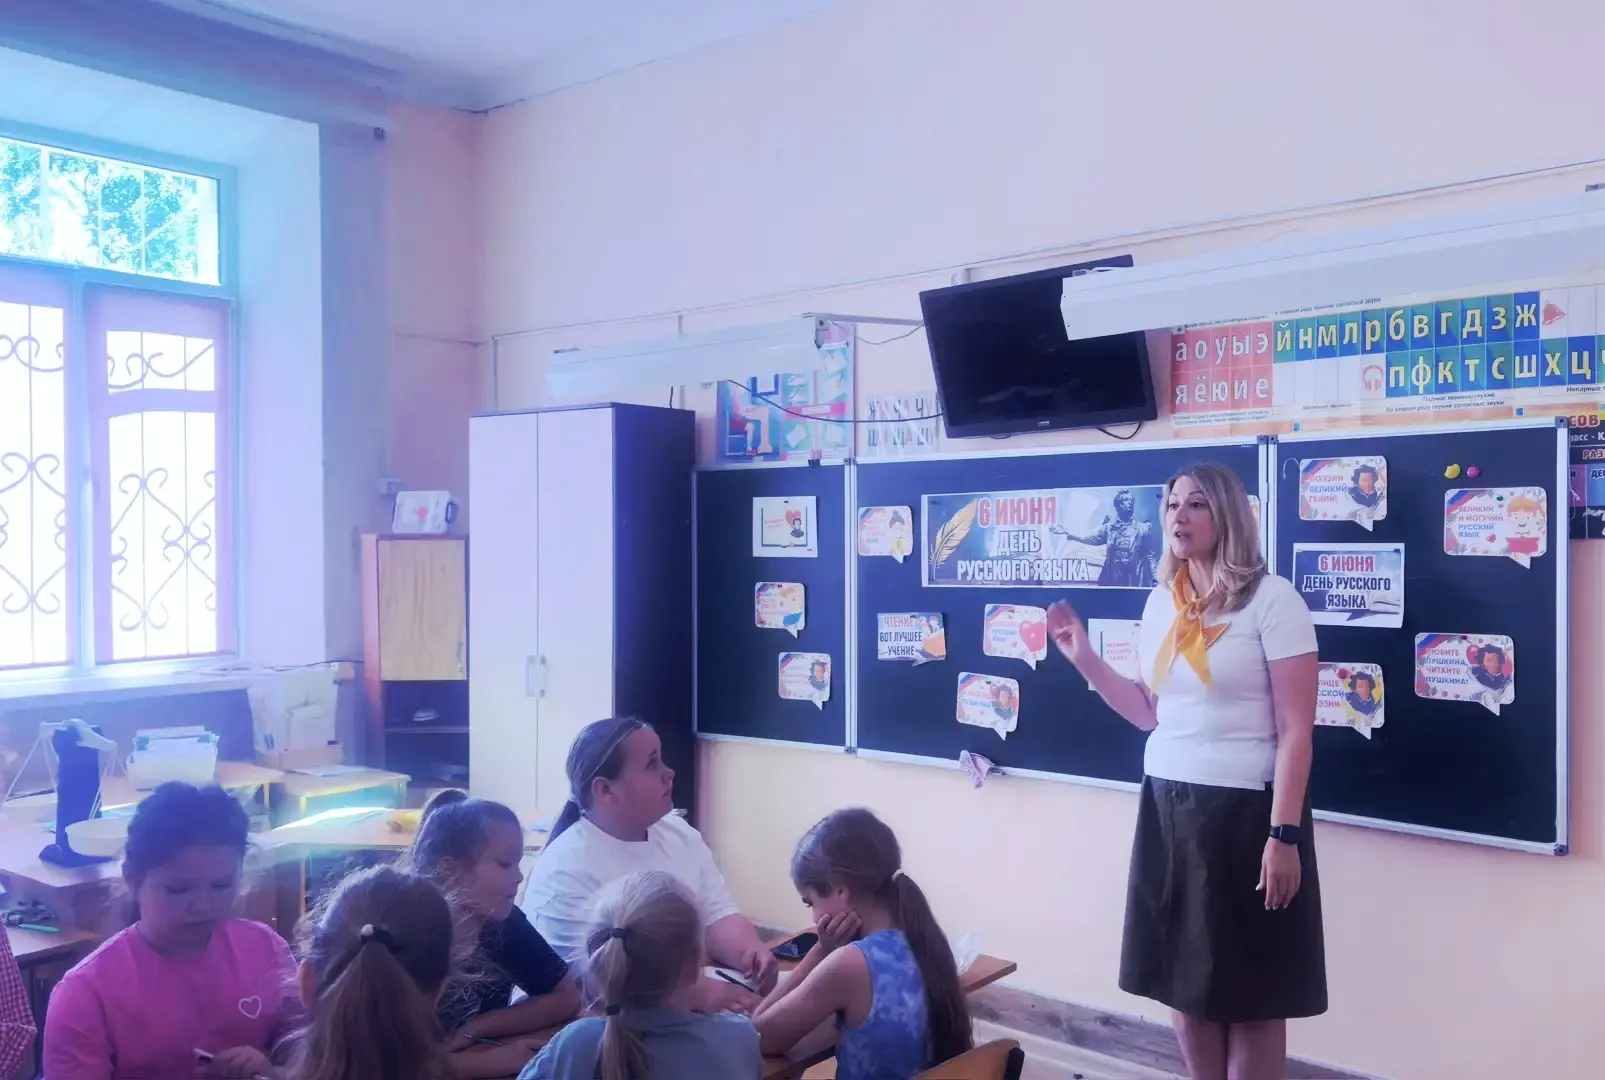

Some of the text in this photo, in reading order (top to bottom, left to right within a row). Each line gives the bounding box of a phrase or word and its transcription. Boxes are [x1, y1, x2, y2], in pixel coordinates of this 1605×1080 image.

[1309, 484, 1347, 493] ВЕЛИКИЙ
[978, 496, 1056, 527] 6 ИЮНЯ
[998, 530, 1041, 556] ДЕНЬ
[957, 559, 1089, 582] РУССКОГО ЯЗЫКА
[1320, 555, 1374, 572] 6 ИЮНЯ
[1304, 575, 1391, 591] ДЕНЬ РУССКОГО
[1327, 594, 1366, 608] ЯЗЫКА
[880, 632, 922, 642] ВОТ ЛУЧШЕЕ
[888, 646, 914, 655] УЧЕНИЕ
